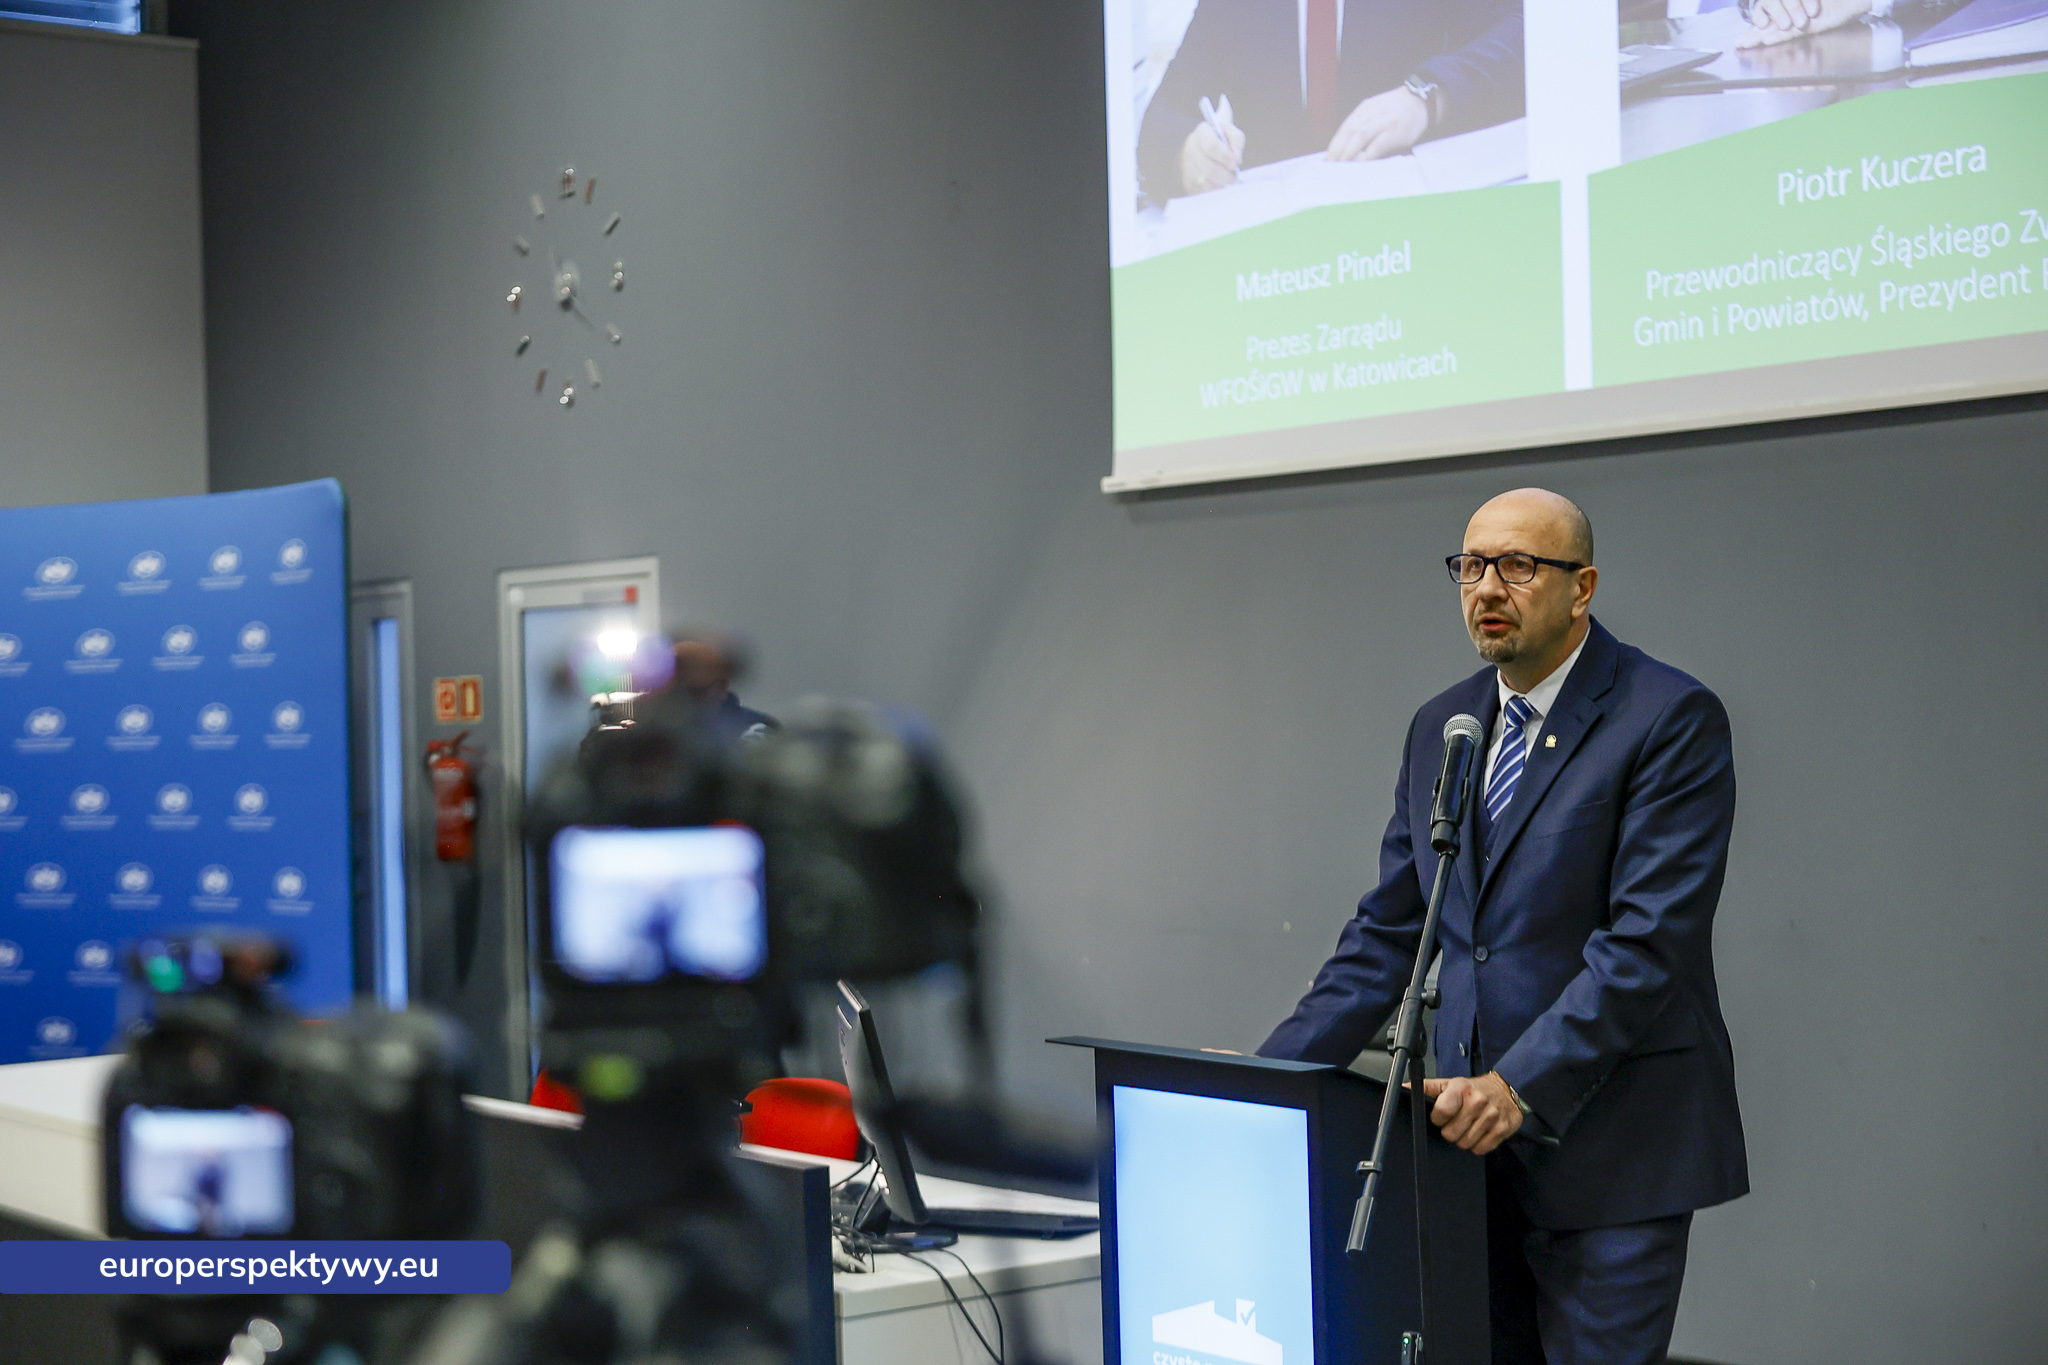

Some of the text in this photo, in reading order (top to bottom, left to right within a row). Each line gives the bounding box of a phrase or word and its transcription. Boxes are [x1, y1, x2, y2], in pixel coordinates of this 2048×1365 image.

[1777, 143, 1987, 206] Piotr Kuczera
[1236, 240, 1412, 302] Mateusz Pindel
[1645, 243, 1862, 300] Przewodniczący
[1870, 223, 2011, 269] Śląskiego
[1634, 313, 1704, 347] Gmin
[1713, 306, 1720, 336] i
[1727, 288, 1869, 336] Powiatów,
[1879, 263, 2032, 313] Prezydent
[1246, 312, 1402, 362] Prezes Zarządu
[1308, 370, 1328, 393] w
[1332, 345, 1458, 389] Katowicach
